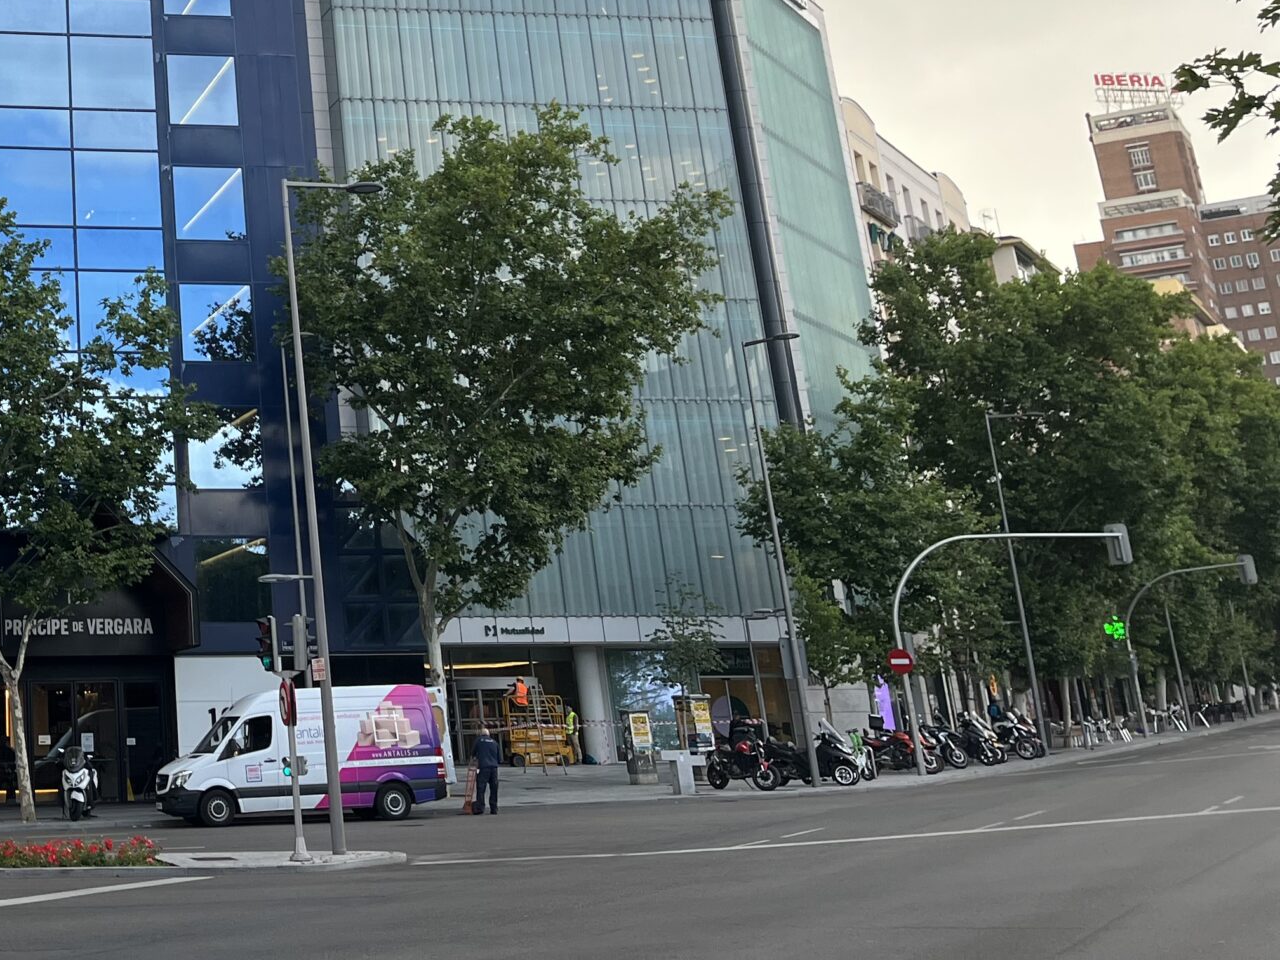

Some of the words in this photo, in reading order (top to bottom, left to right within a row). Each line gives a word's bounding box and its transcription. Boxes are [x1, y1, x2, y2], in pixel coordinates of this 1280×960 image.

[1093, 73, 1165, 87] IBERIA
[72, 620, 84, 632] DE
[86, 617, 154, 635] VERGARA
[500, 626, 545, 635] Mutualidad
